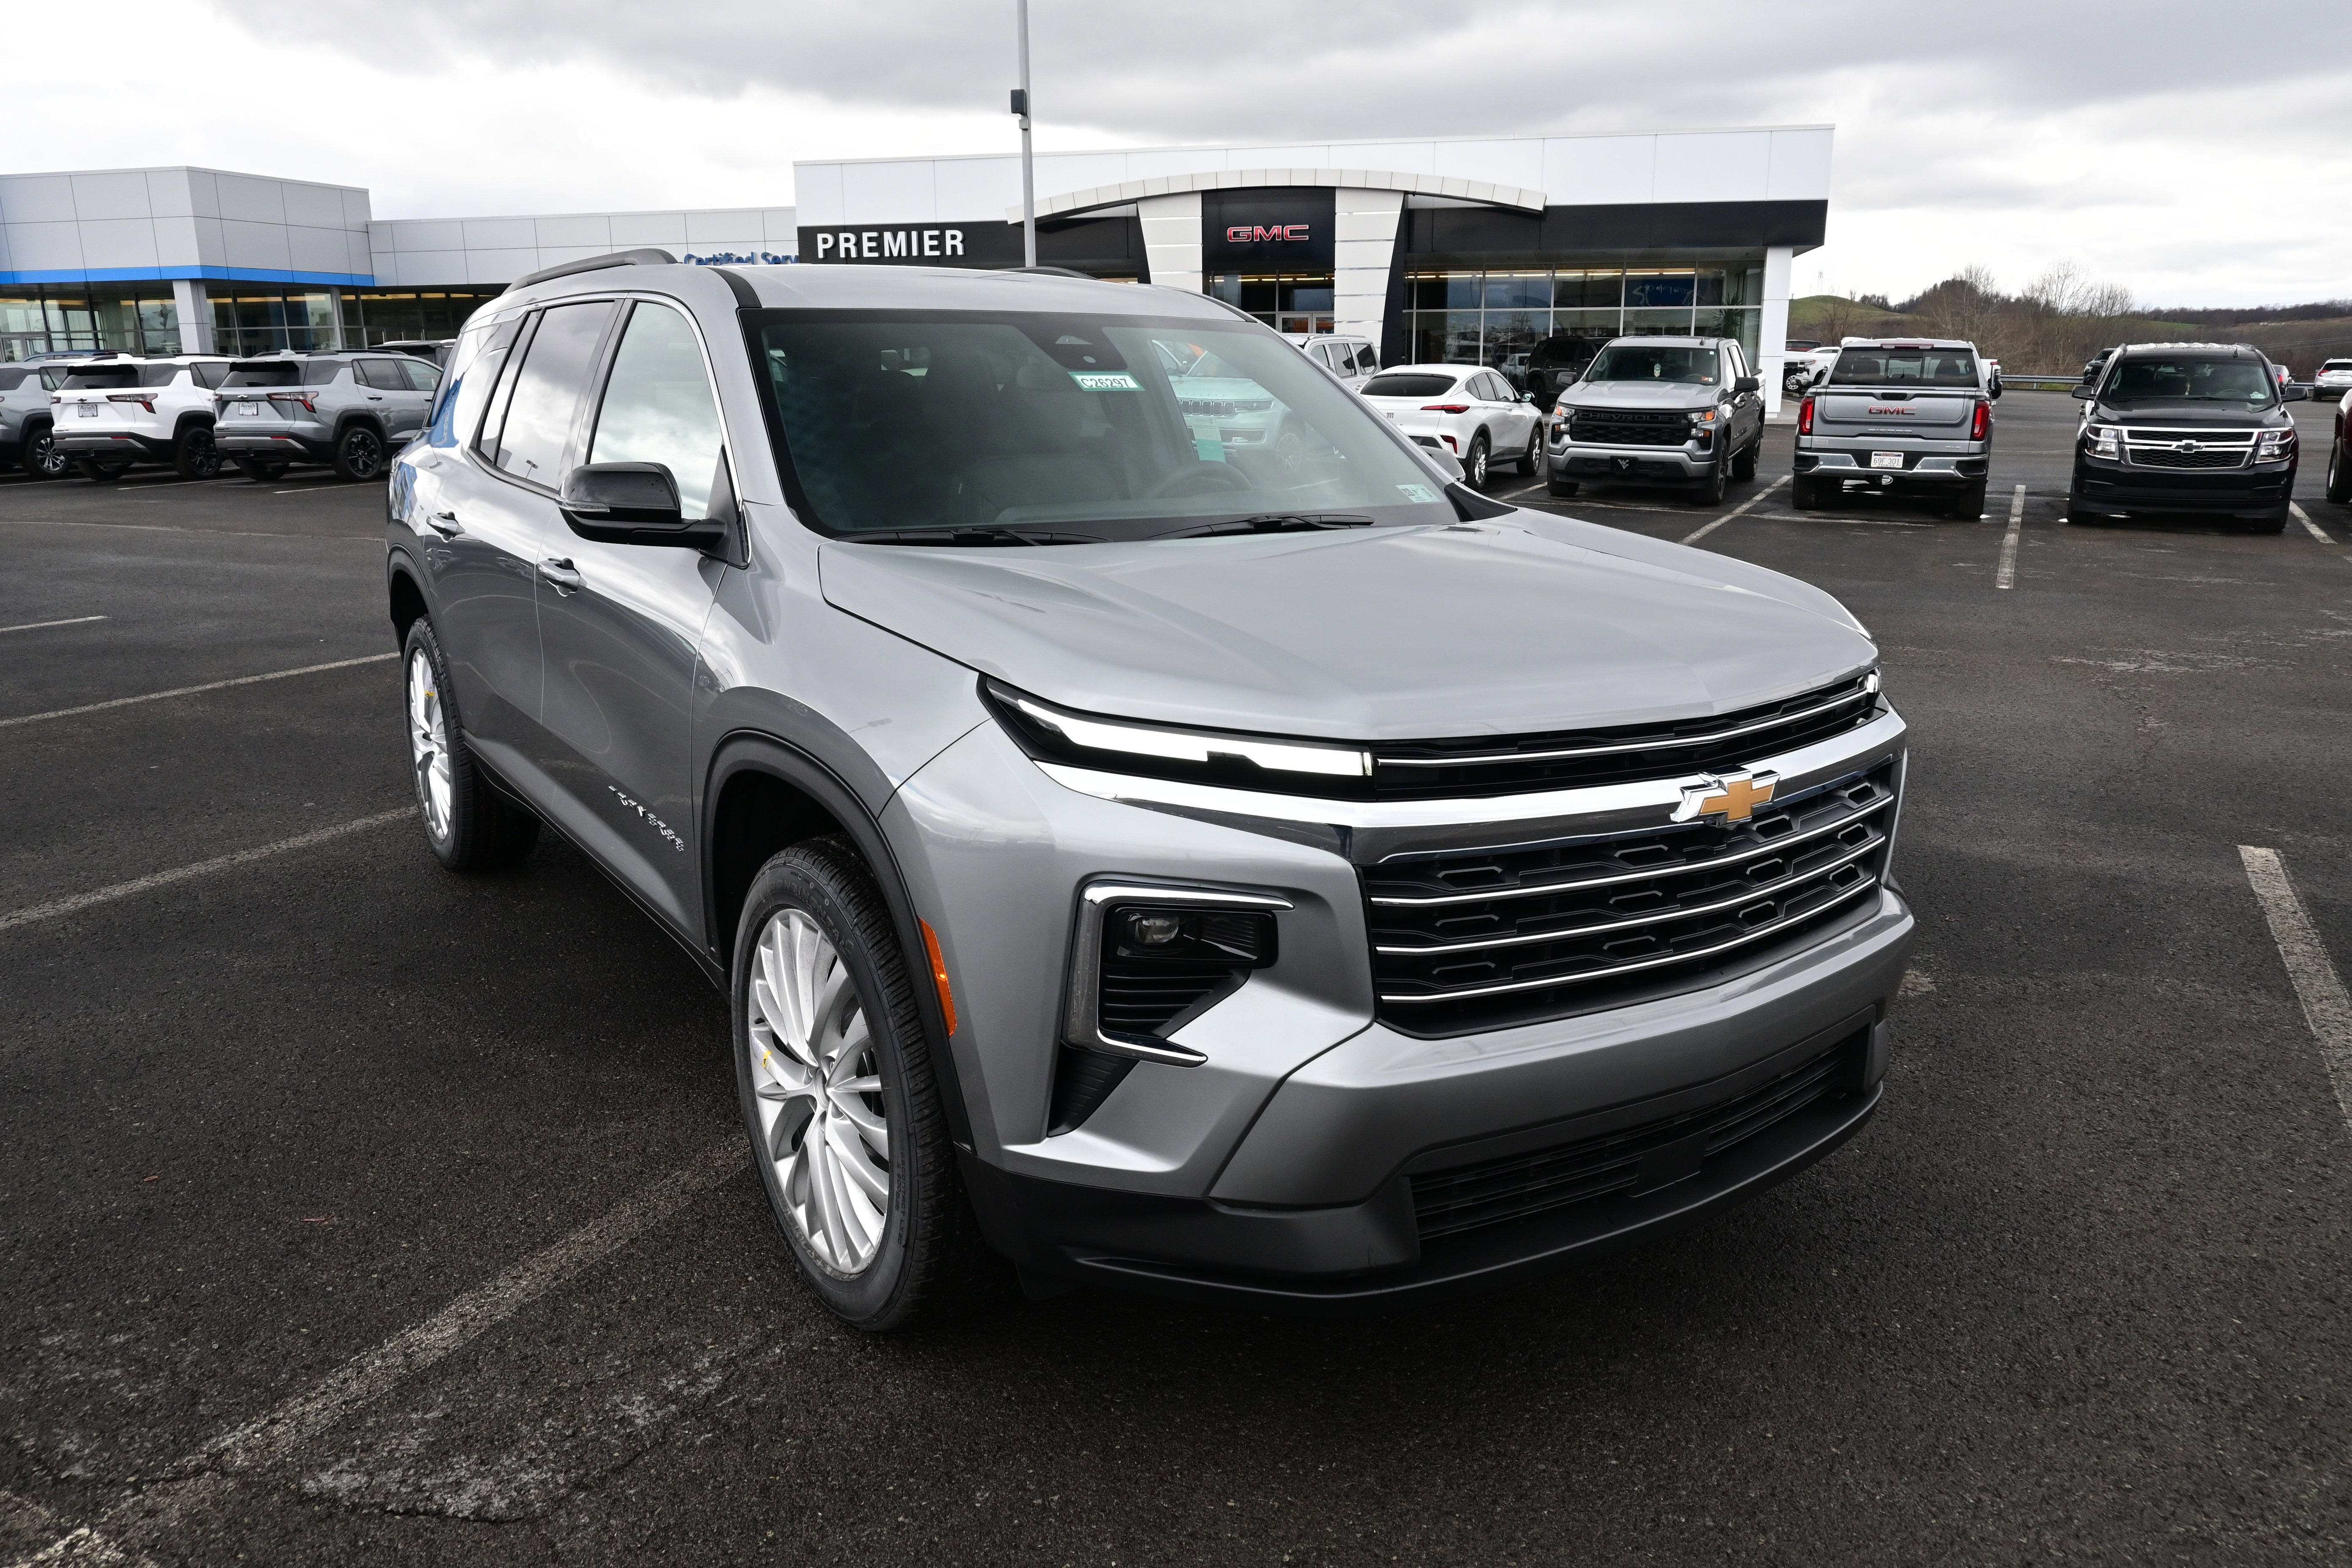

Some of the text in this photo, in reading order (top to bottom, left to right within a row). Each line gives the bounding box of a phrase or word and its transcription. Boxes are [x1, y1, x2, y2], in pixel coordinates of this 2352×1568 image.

[1227, 225, 1309, 242] GMC
[817, 229, 965, 259] PREMIER
[684, 252, 755, 266] Certified
[1081, 378, 1129, 387] C26297
[1580, 412, 1681, 422] CHEVROLET
[1869, 406, 1916, 415] GMC
[608, 785, 684, 852] TRAVERSE
